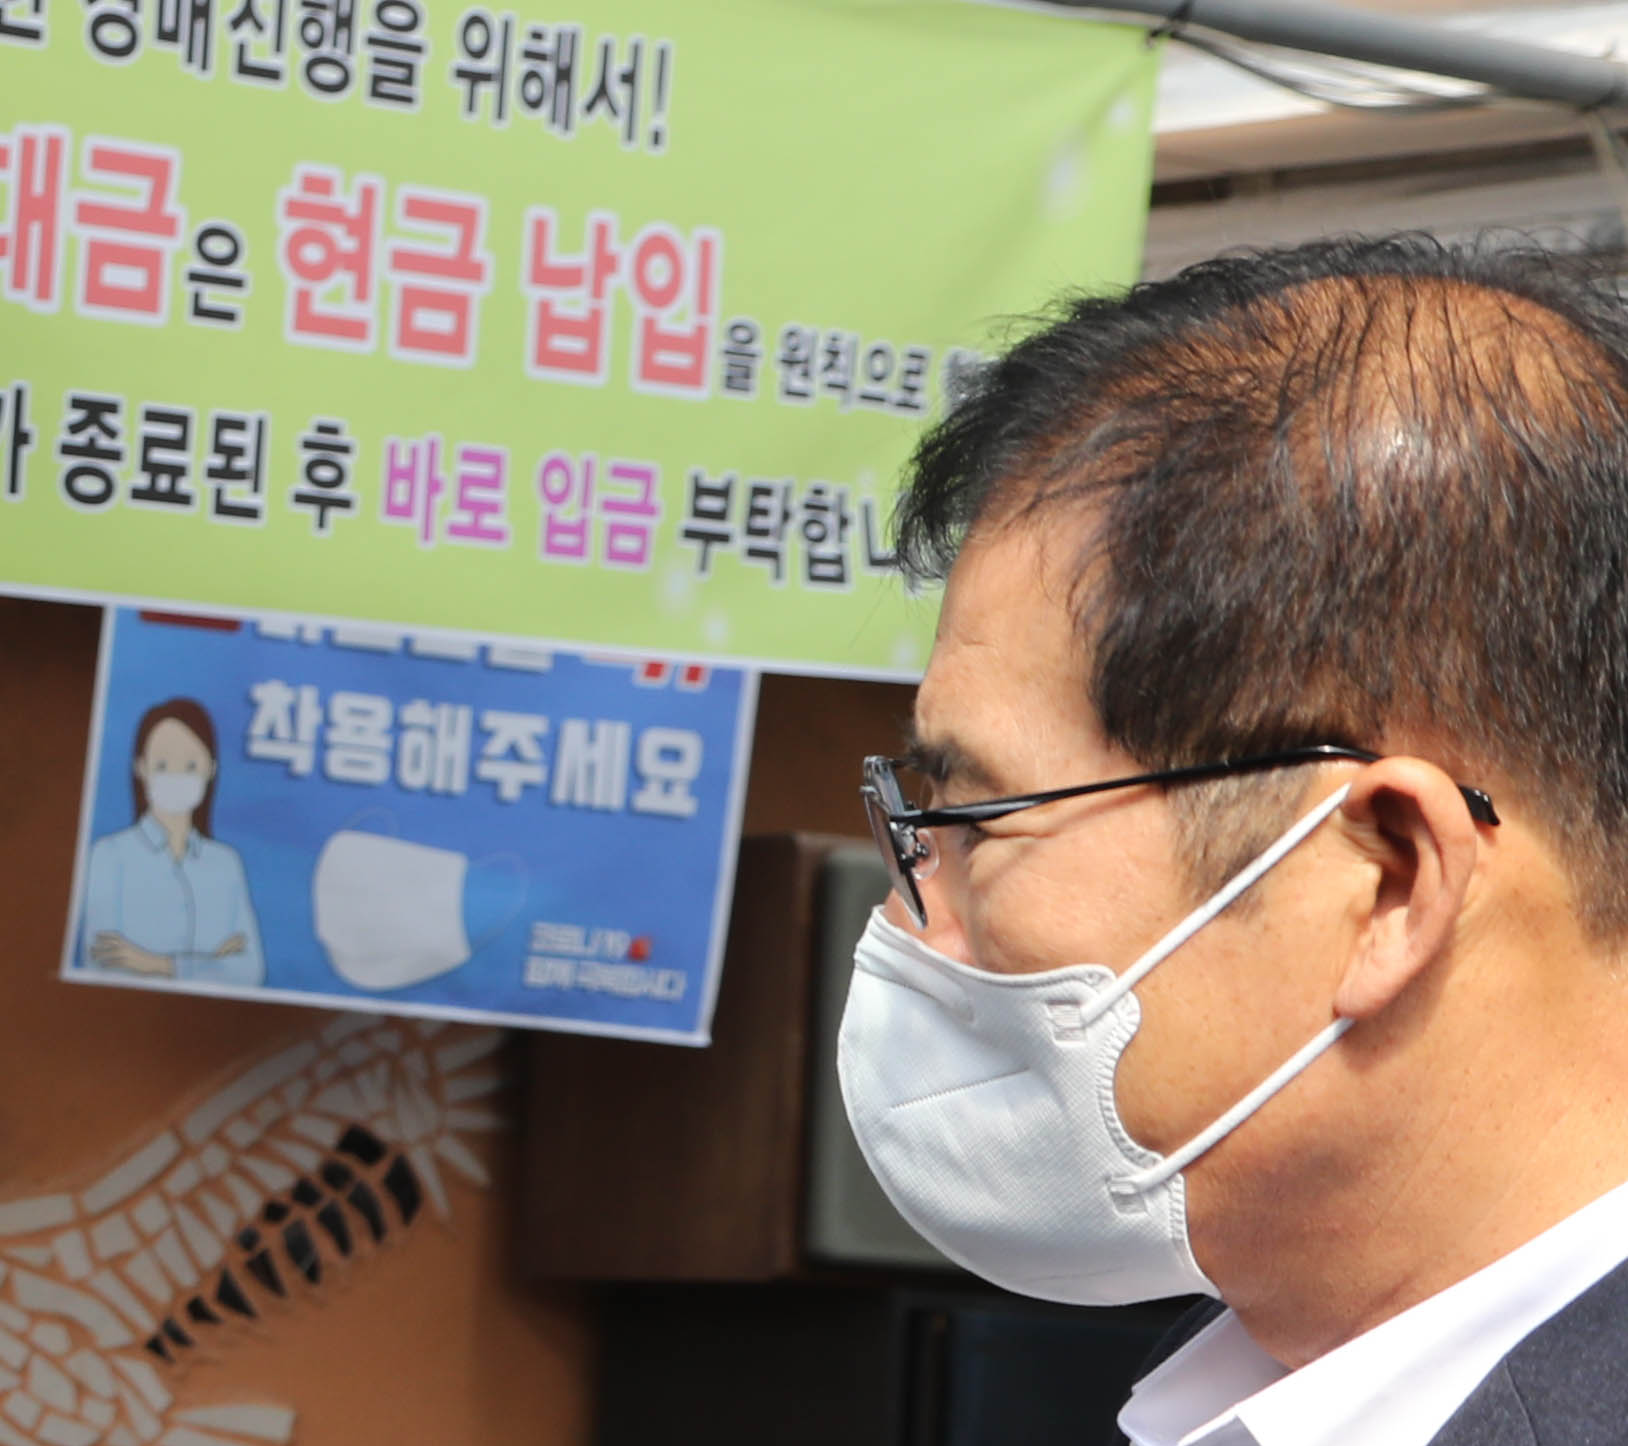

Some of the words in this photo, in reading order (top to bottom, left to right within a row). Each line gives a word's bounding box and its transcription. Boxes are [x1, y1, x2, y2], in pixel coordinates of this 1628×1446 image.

[454, 14, 669, 147] 위해서!
[282, 174, 488, 359] 현금
[525, 215, 757, 392] 납입을
[779, 328, 926, 410] 원칙으로
[58, 395, 265, 521] 종료된
[293, 423, 354, 528] 후
[382, 440, 508, 545] 바로
[538, 456, 661, 568] 입금
[246, 681, 702, 817] 착용해주세요
